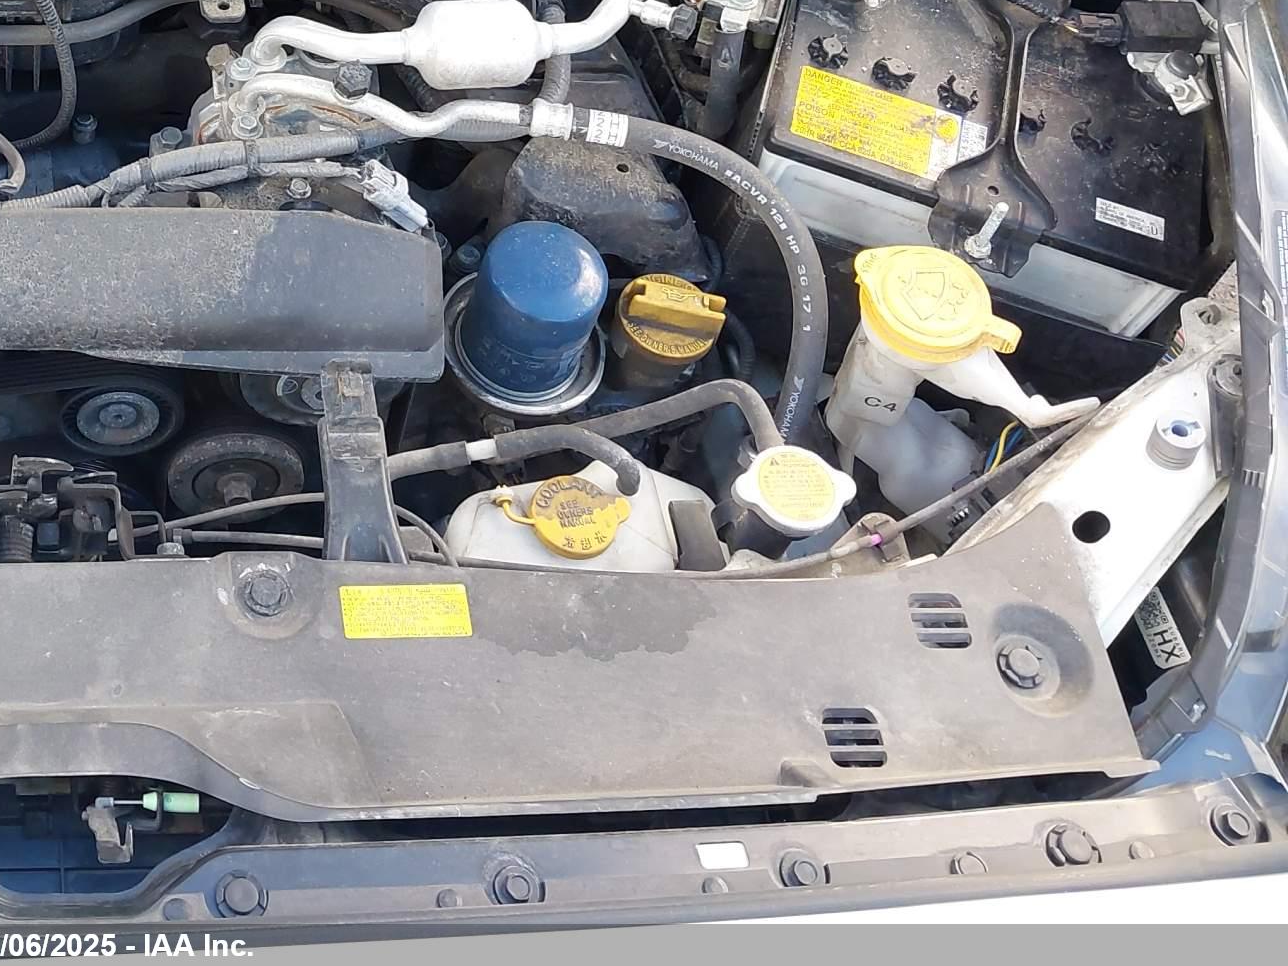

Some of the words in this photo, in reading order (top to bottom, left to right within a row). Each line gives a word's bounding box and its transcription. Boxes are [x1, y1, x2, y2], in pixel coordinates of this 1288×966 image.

[804, 68, 843, 87] DANGER
[798, 101, 835, 118] POISON
[666, 143, 720, 172] YOKOHAMA
[786, 235, 800, 255] HP
[797, 264, 809, 286] 3G
[801, 295, 812, 313] 17
[864, 396, 897, 413] C4
[535, 478, 602, 509] COOLANT
[559, 499, 579, 510] SEE
[1152, 628, 1182, 664] HX
